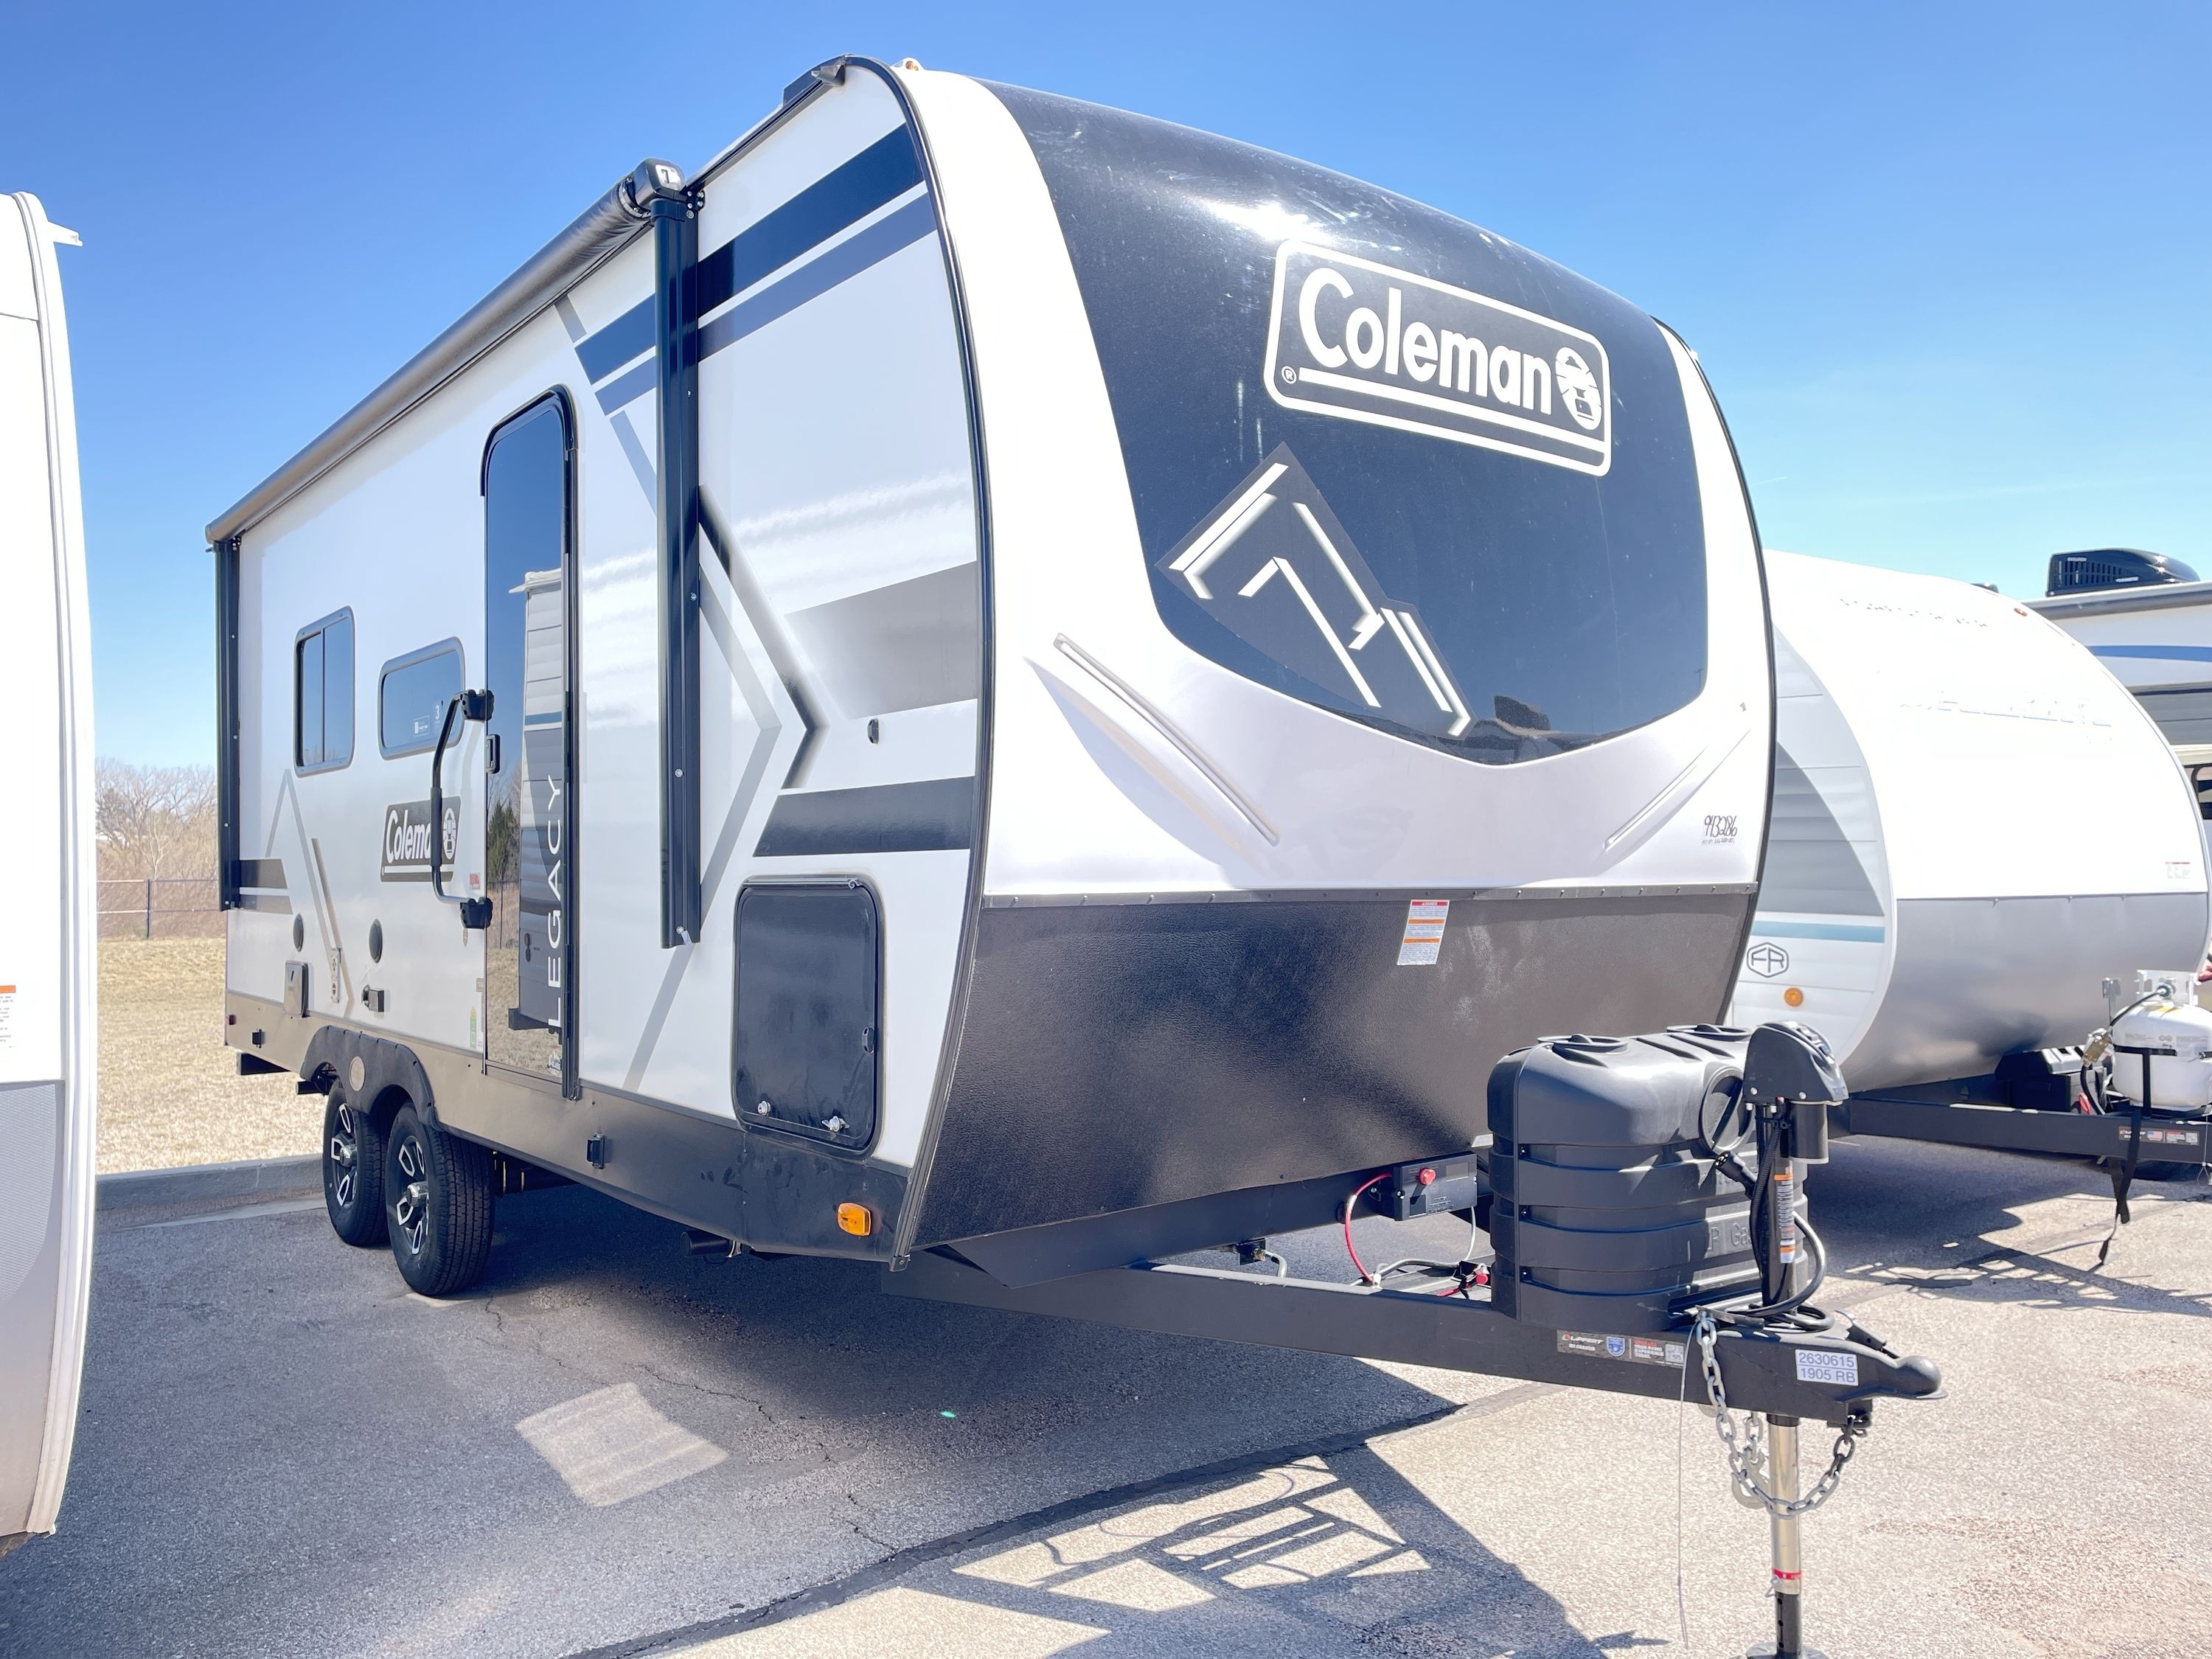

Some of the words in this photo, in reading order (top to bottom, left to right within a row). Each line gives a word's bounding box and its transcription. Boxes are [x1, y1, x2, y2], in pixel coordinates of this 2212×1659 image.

[1298, 267, 1551, 415] Coleman
[386, 810, 431, 864] Colema
[548, 774, 561, 1027] LEGACY
[1799, 1352, 1854, 1368] 2630615
[1801, 1368, 1832, 1380] 1905
[1836, 1371, 1856, 1382] RB
